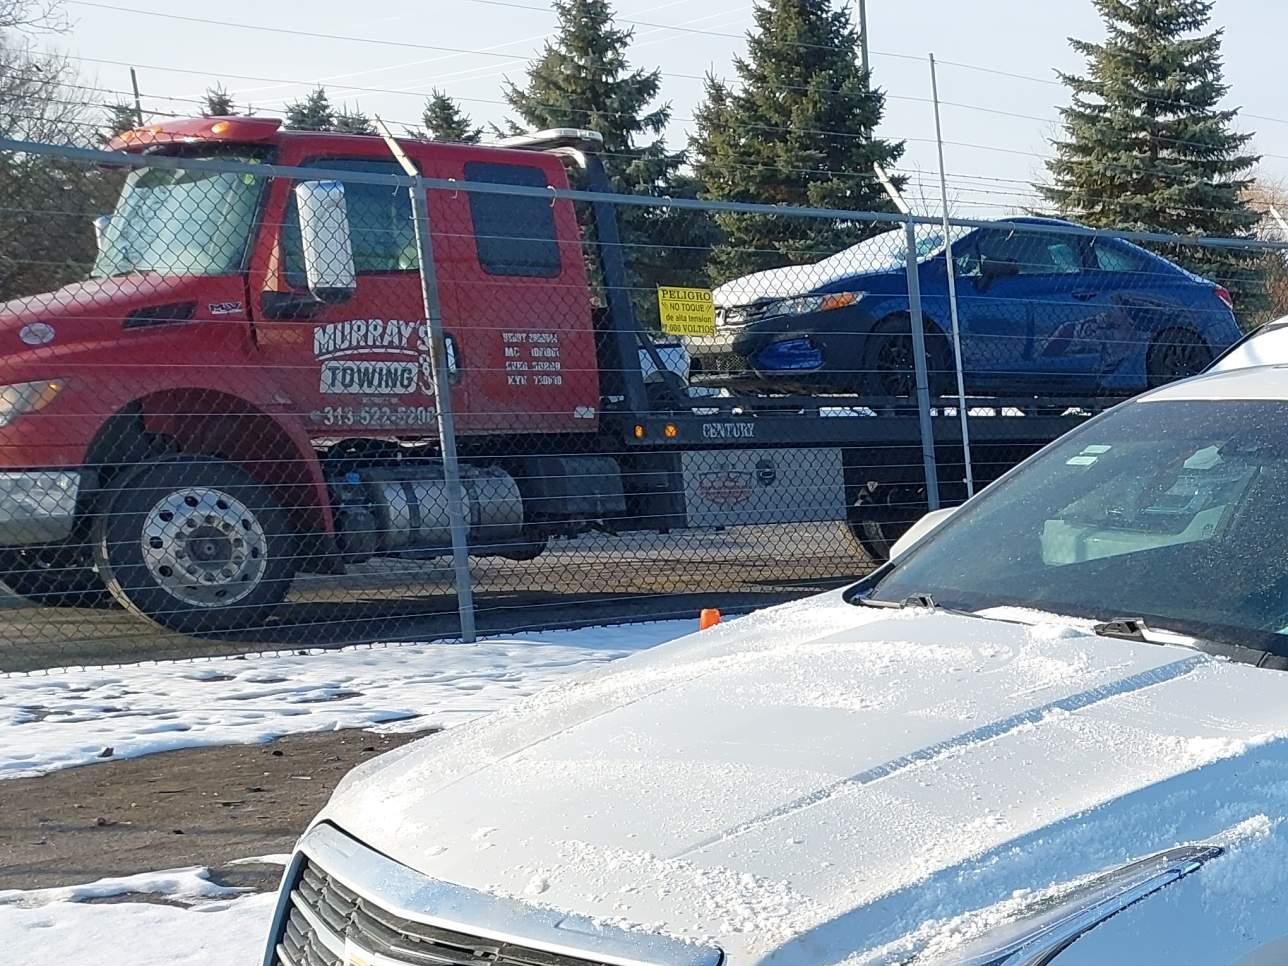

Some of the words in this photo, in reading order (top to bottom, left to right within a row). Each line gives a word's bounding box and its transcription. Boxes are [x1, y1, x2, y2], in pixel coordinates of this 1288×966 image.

[662, 289, 711, 301] PELIGRO
[669, 302, 680, 312] NO
[681, 303, 705, 312] TOQUE
[665, 313, 674, 322] de
[682, 324, 715, 335] VOLTIOS
[313, 319, 429, 355] MURRAY'S
[326, 365, 414, 389] TOWING
[702, 422, 755, 438] CENTURY
